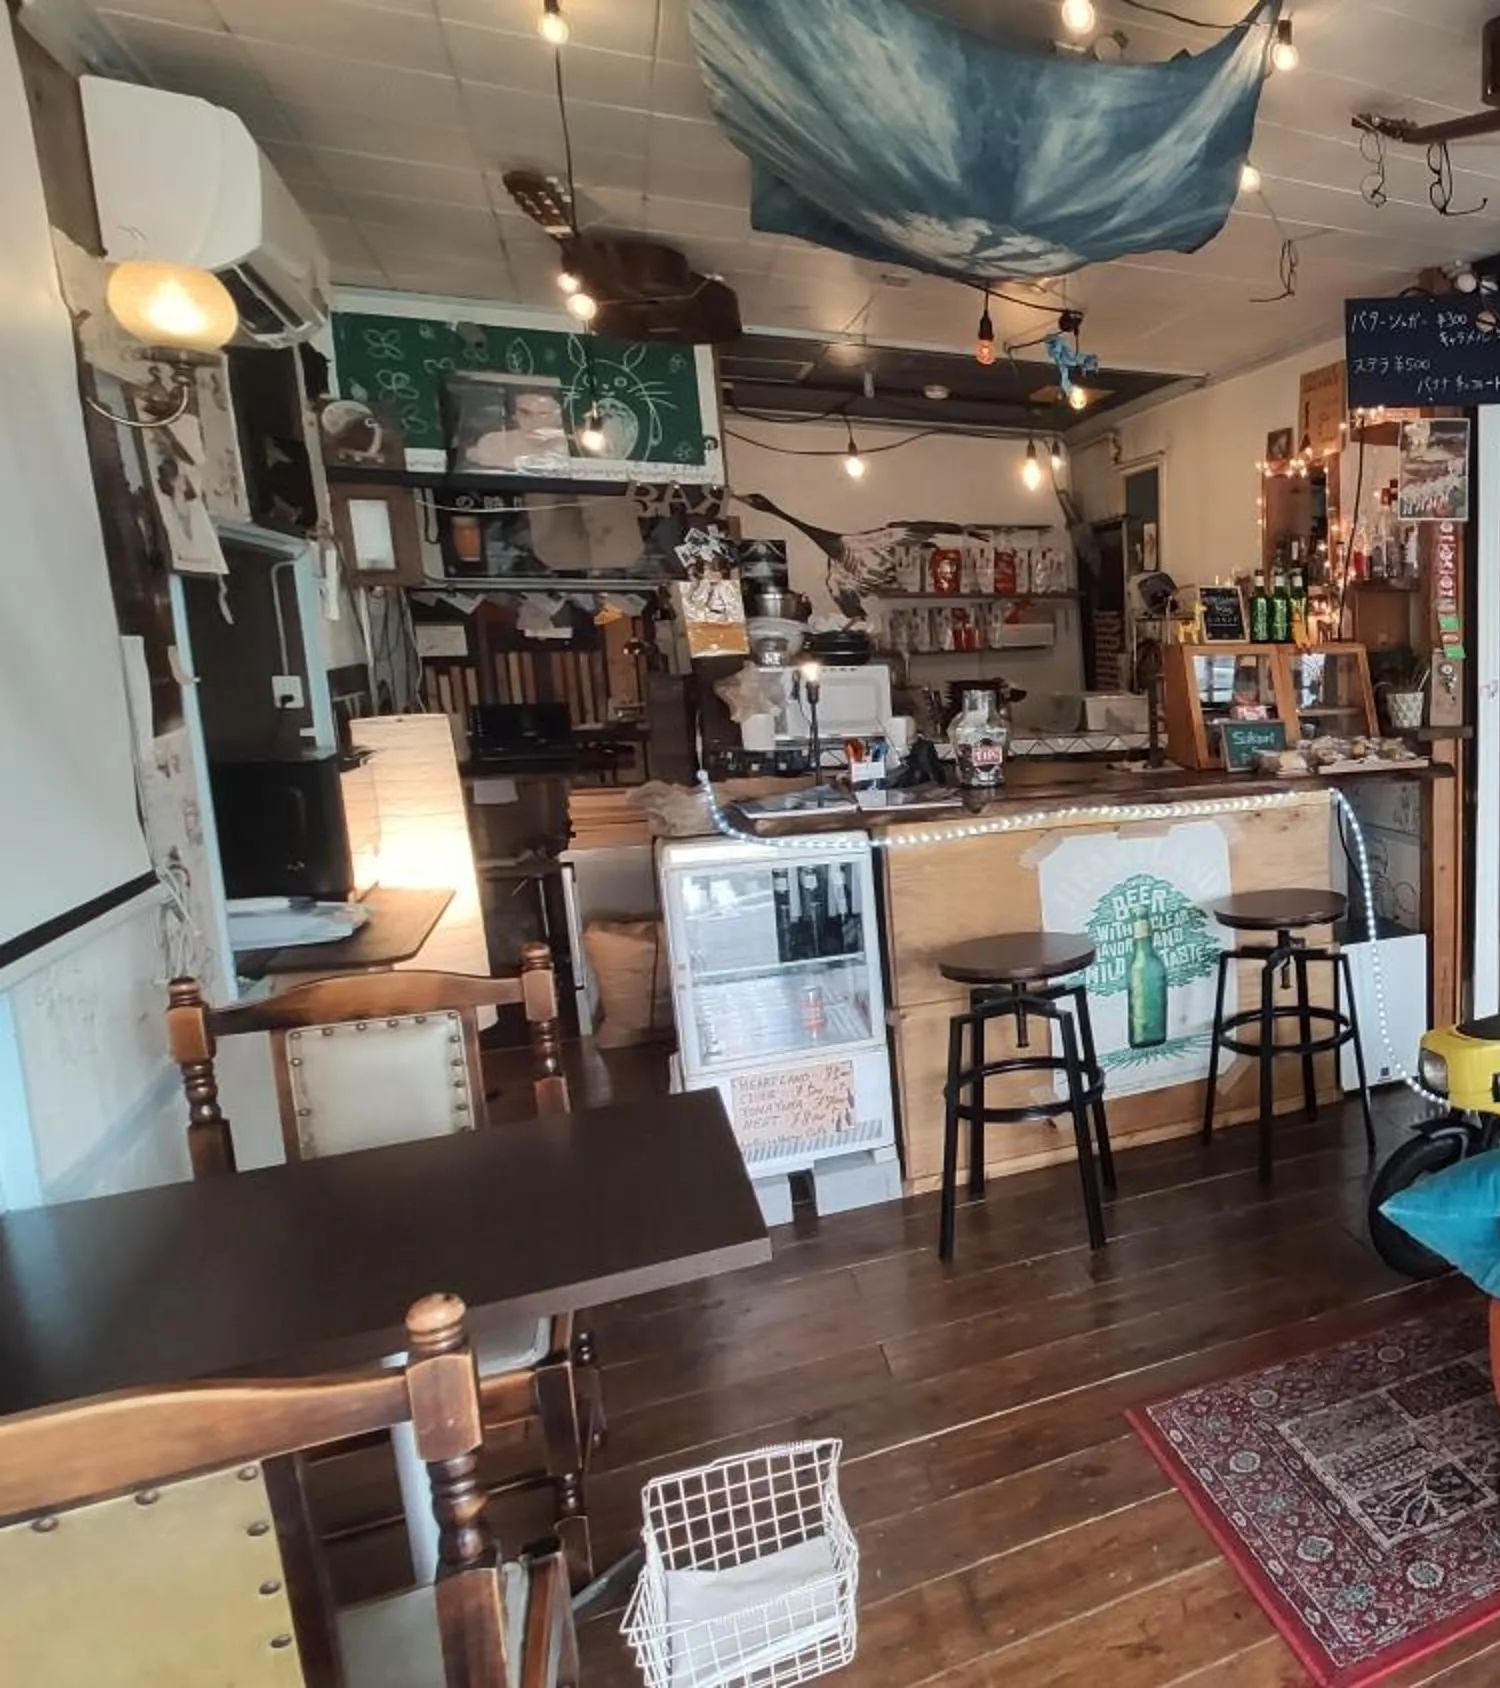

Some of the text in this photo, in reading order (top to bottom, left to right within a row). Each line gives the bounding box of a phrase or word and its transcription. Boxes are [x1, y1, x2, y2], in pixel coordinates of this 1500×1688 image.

[1111, 885, 1167, 920] BEER
[1096, 921, 1132, 941] WITH
[1096, 927, 1183, 962] LAVOR AND
